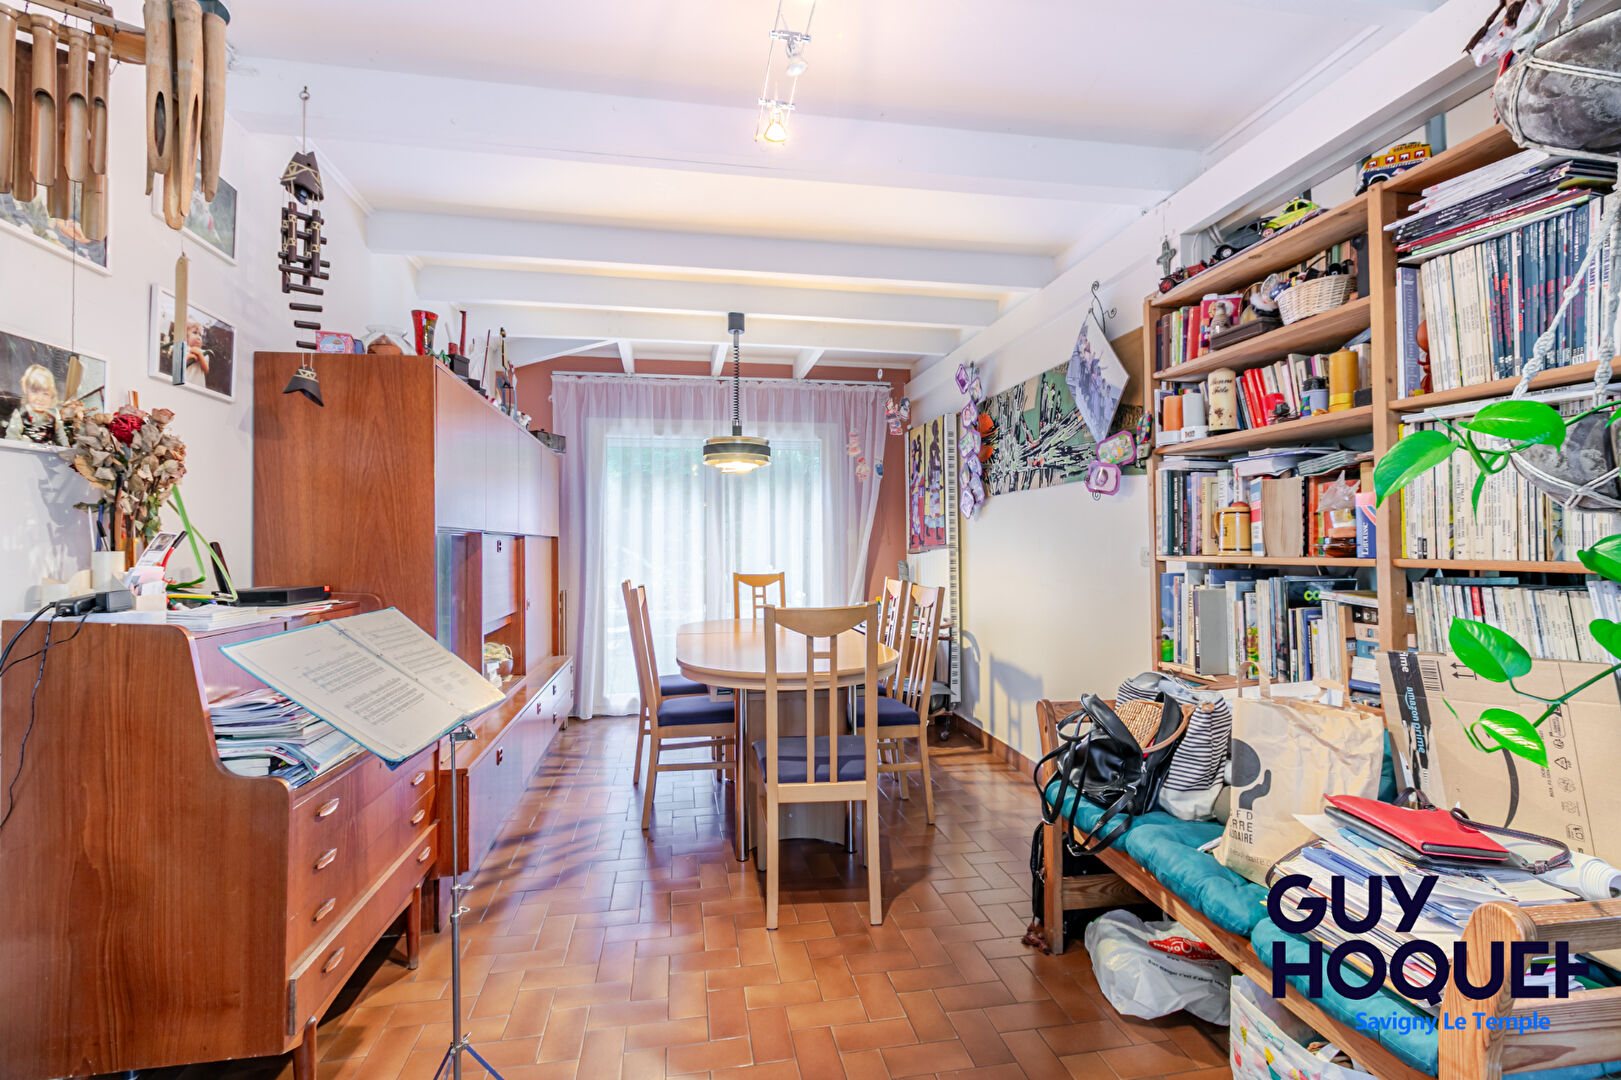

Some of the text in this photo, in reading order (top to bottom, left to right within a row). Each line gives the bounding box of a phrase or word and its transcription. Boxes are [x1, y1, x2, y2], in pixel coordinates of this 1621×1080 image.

[1405, 686, 1425, 754] amazon prime
[1230, 819, 1254, 833] RRE
